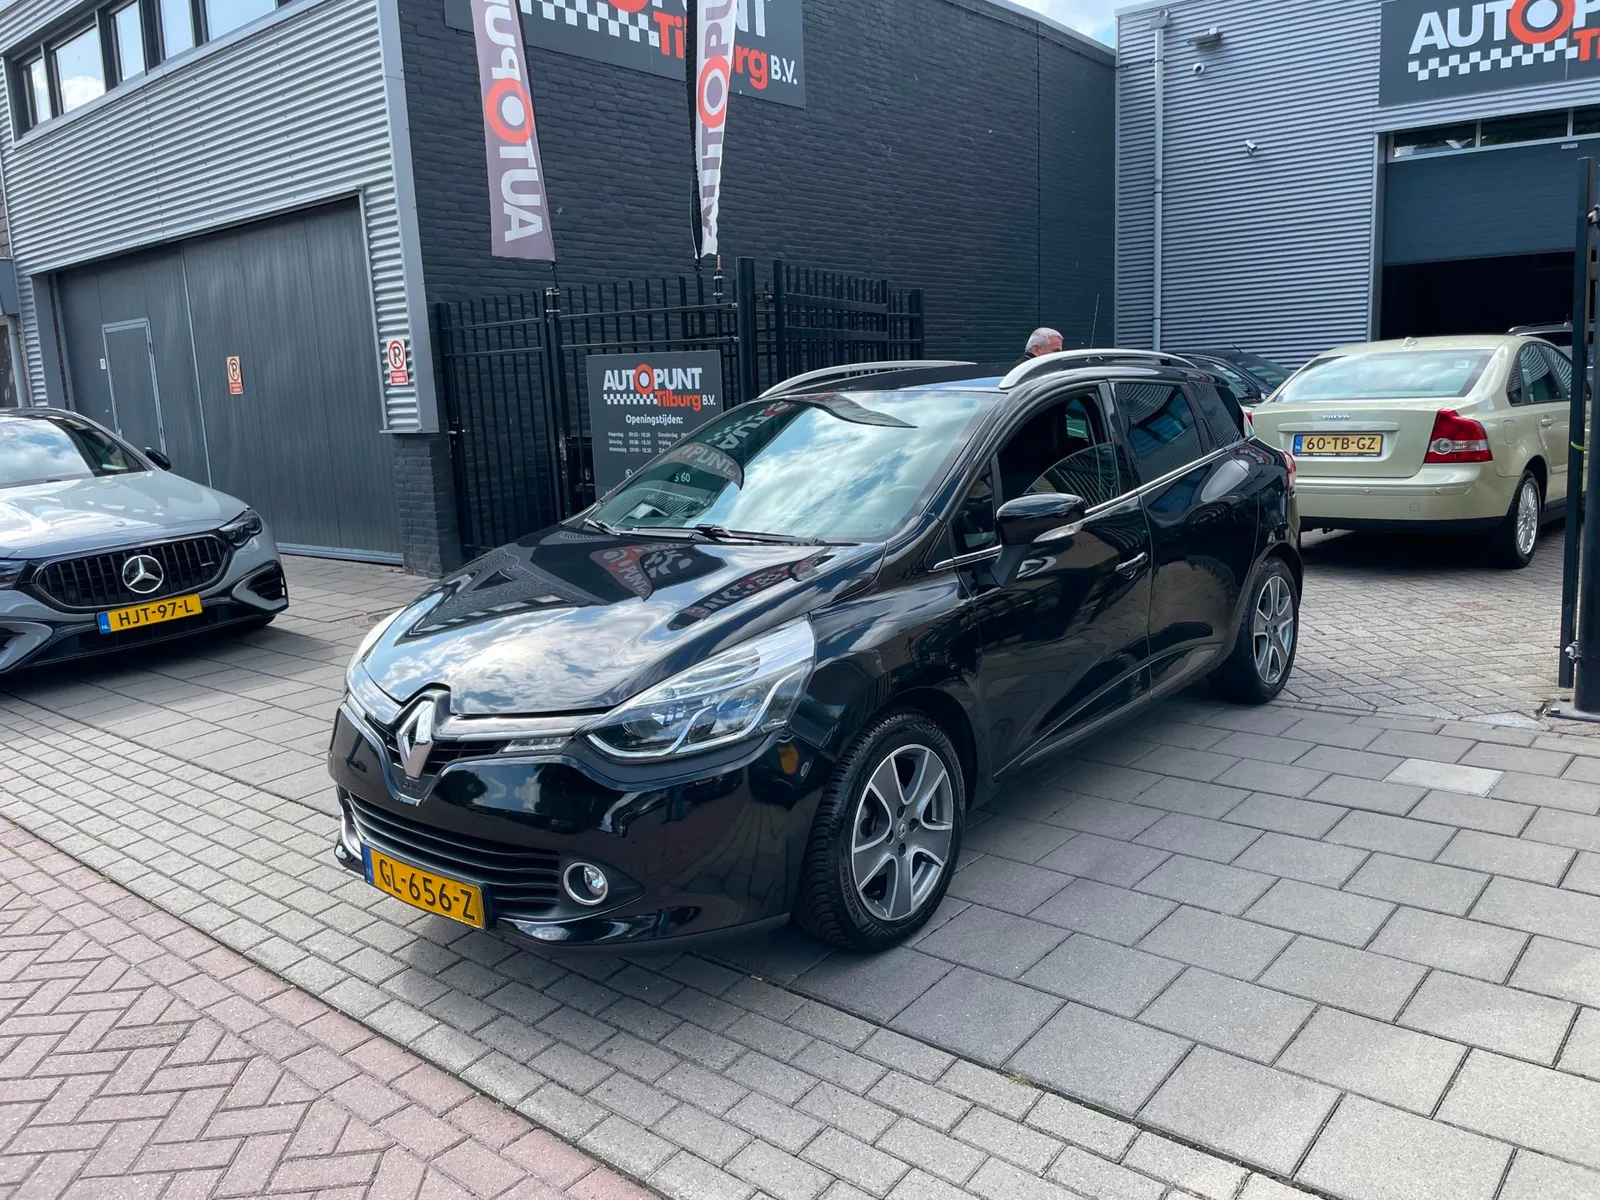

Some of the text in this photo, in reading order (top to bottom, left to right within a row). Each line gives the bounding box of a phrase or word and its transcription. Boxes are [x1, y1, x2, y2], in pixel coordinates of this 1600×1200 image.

[652, 11, 769, 90] Tirg
[770, 54, 798, 85] B.V.
[602, 363, 703, 395] AUTOPUNT
[654, 389, 716, 412] Tilburg B.V.
[625, 414, 684, 426] Openingstijden:
[1306, 437, 1376, 450] 60-TB-GZ
[118, 600, 194, 627] HJT-97-L
[379, 858, 477, 921] GL-656-Z
